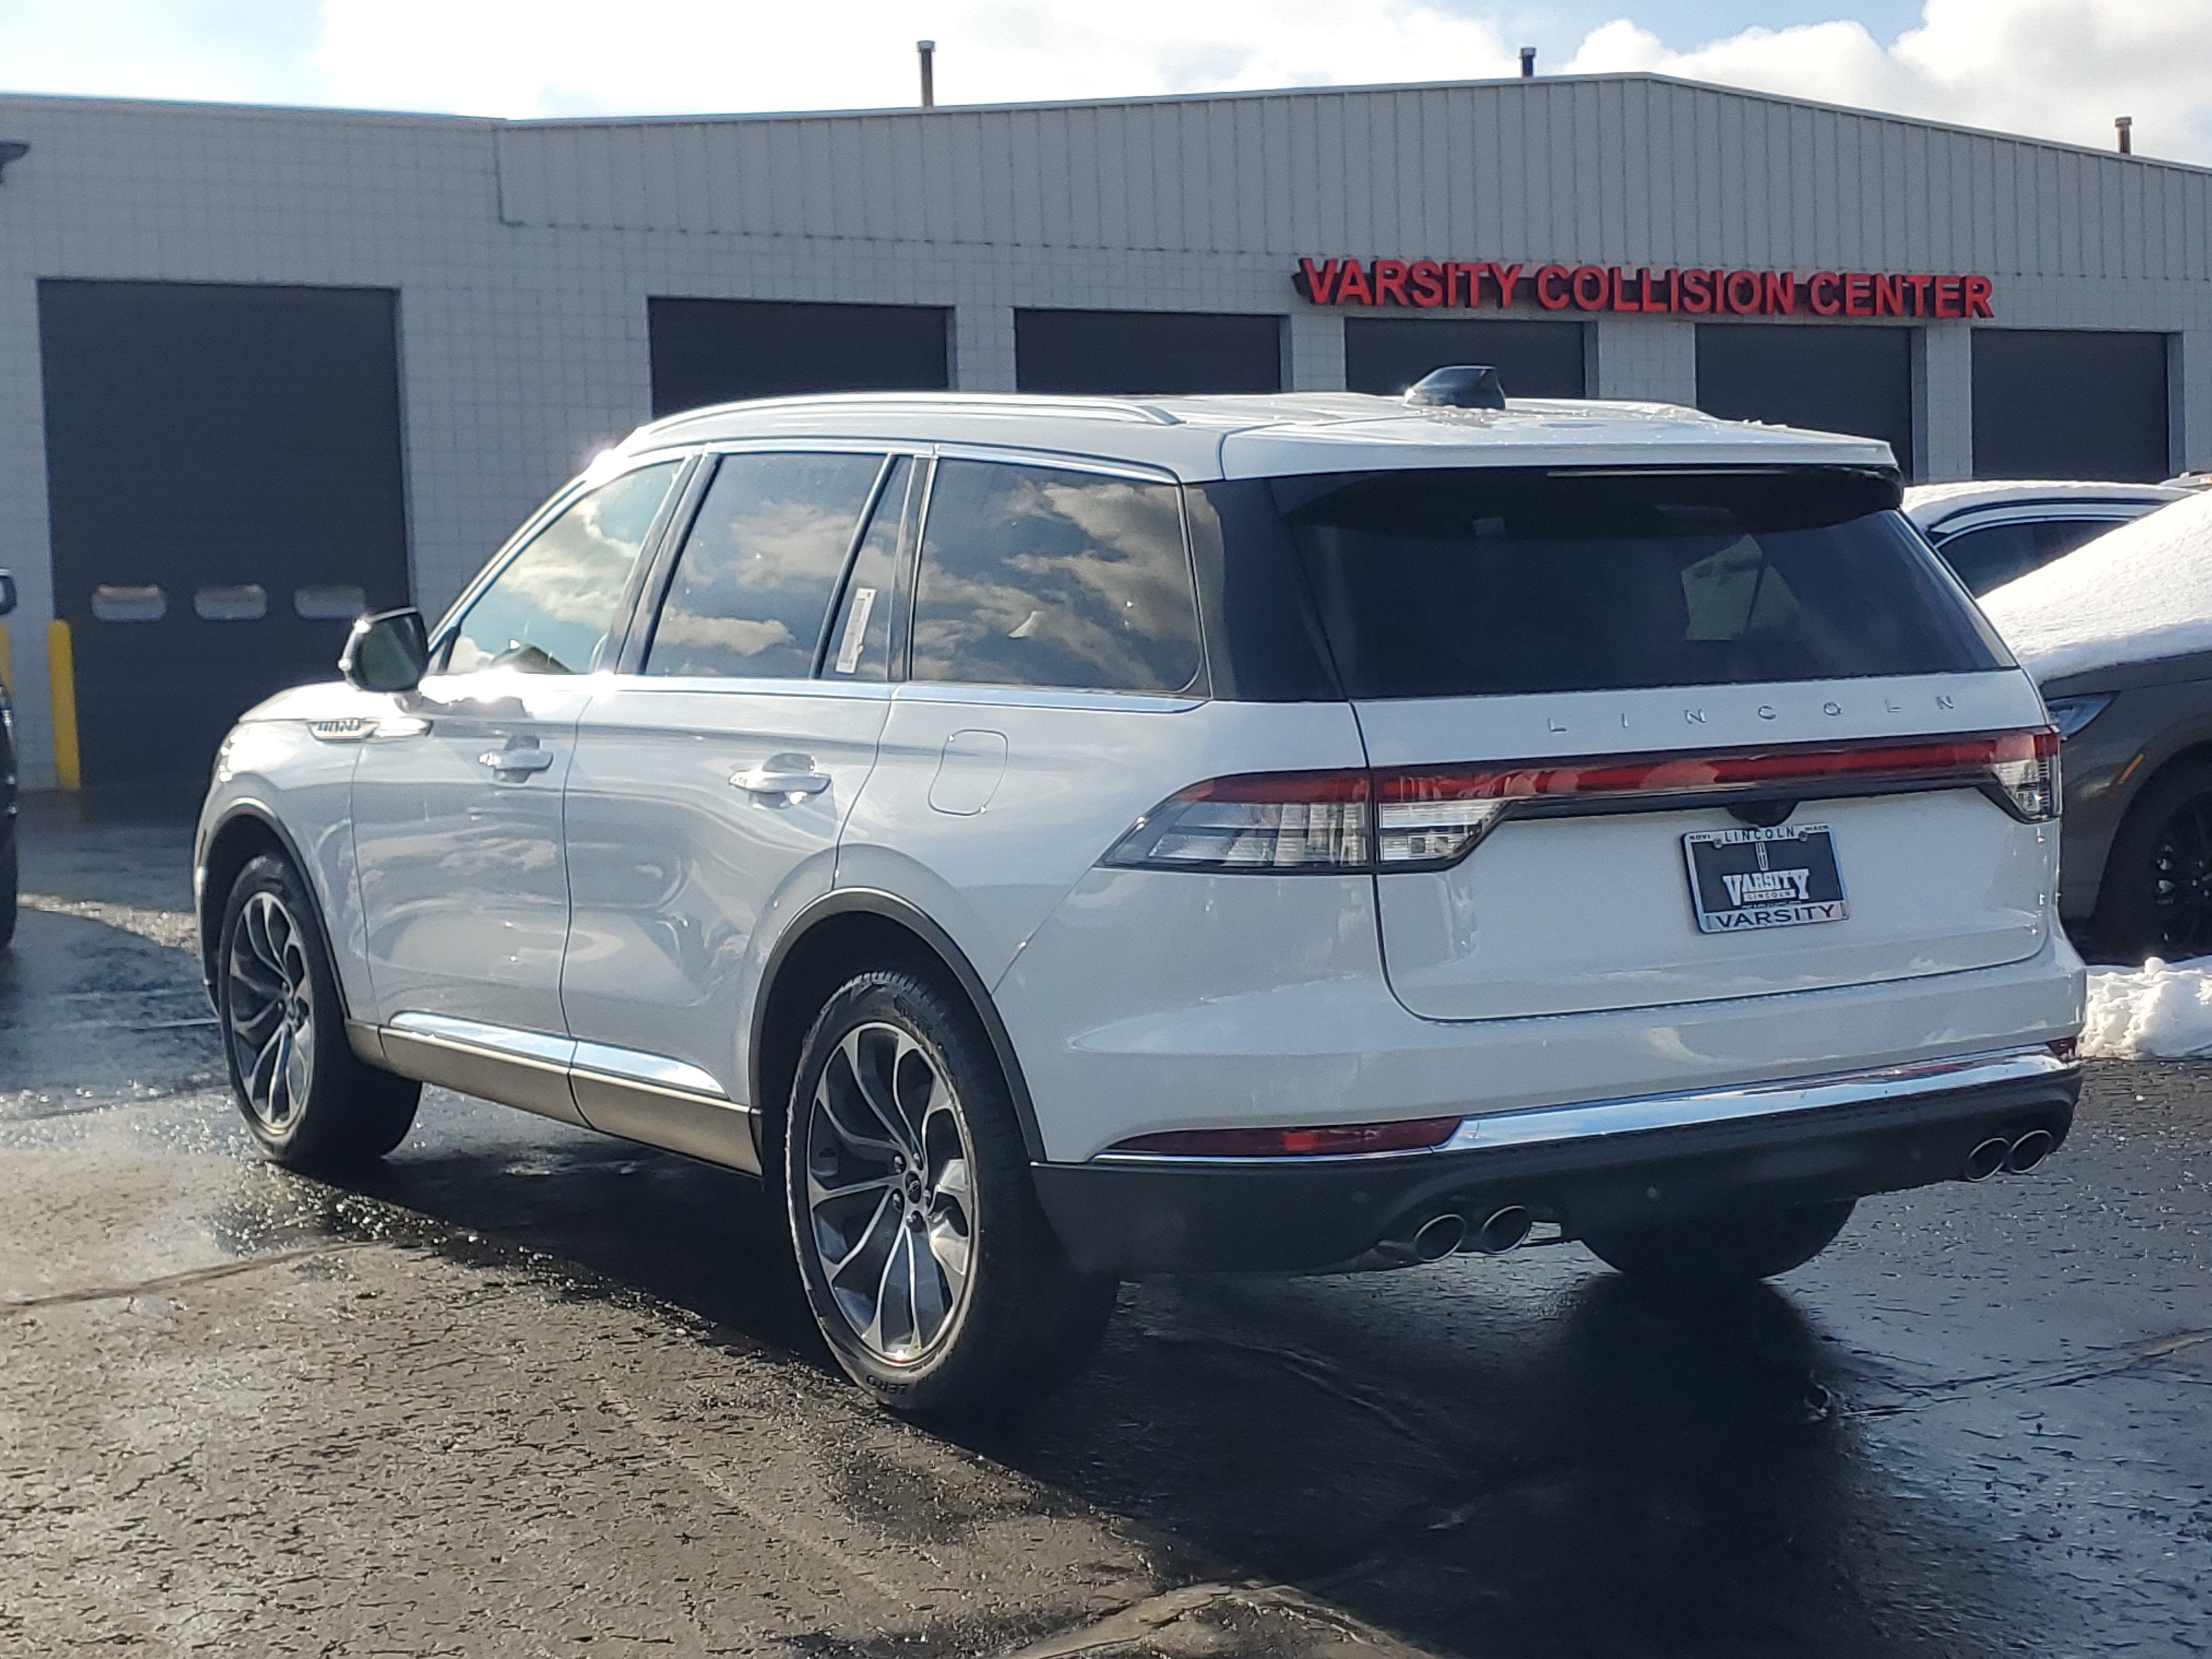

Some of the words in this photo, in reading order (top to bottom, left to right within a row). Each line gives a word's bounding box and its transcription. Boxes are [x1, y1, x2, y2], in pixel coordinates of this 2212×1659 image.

[1300, 257, 1523, 308] VARSITY
[1536, 266, 1795, 314] COLLISION
[1810, 273, 1994, 317] CENTER
[1547, 695, 1955, 733] LINCOLN
[1724, 826, 1795, 842] LINCOLN
[1722, 868, 1809, 906] VARSITY
[1746, 890, 1791, 900] LINCOLN
[1716, 904, 1835, 928] VARSITY
[866, 1374, 910, 1395] ZERO
